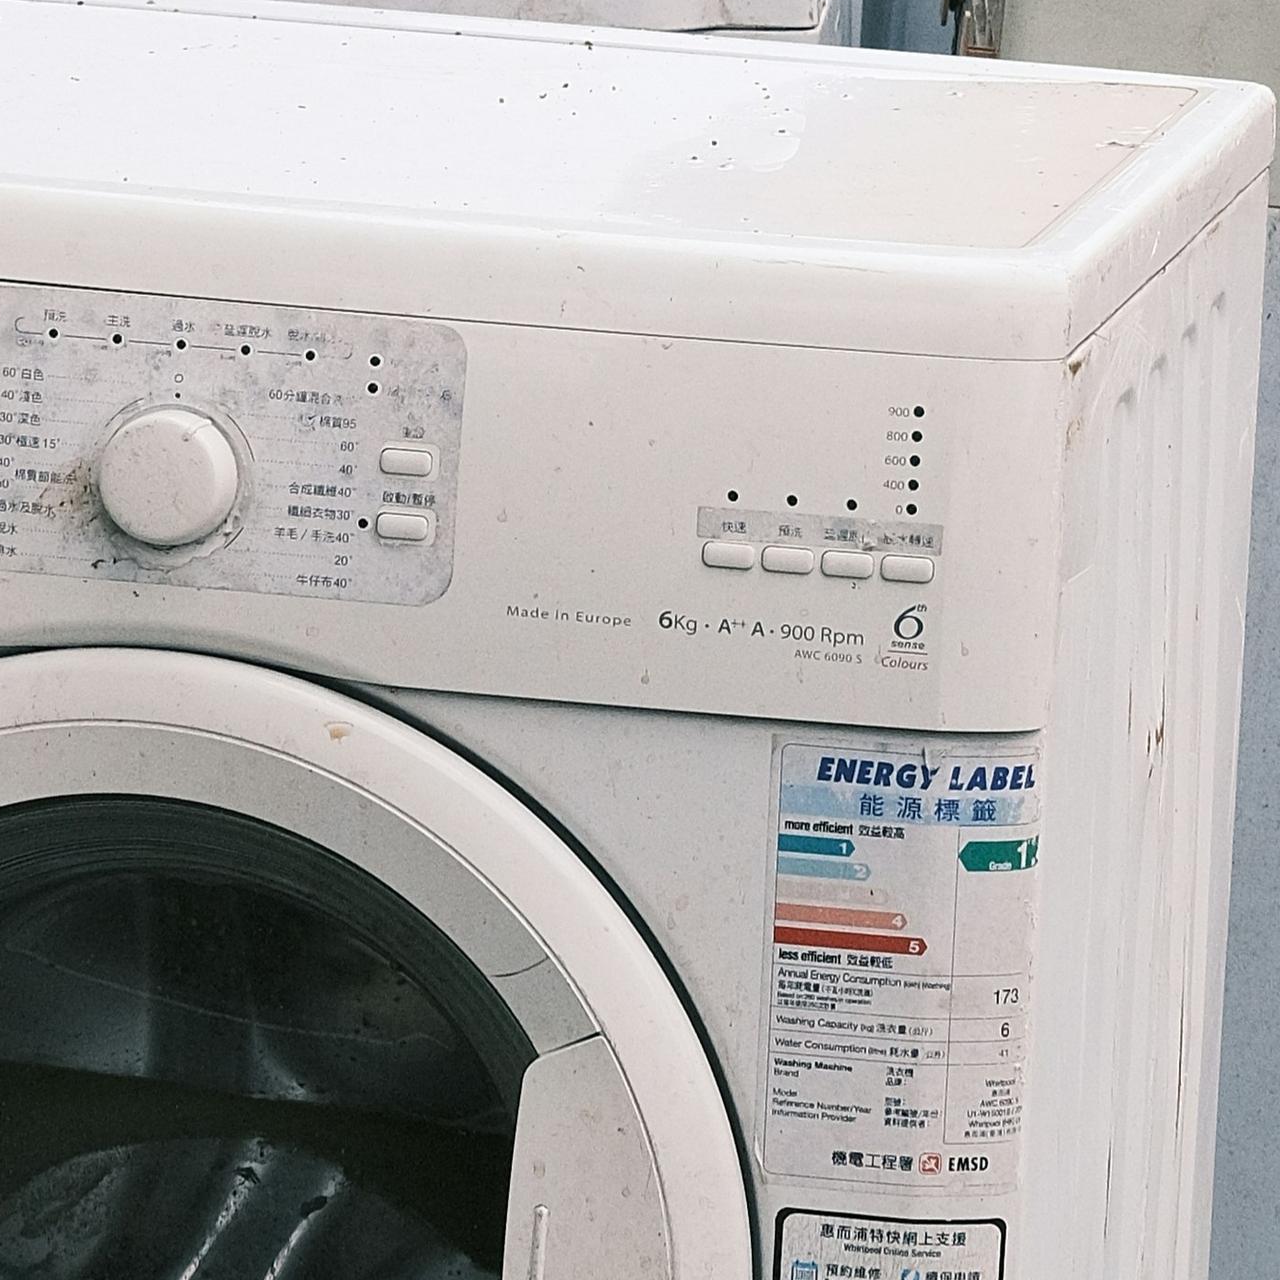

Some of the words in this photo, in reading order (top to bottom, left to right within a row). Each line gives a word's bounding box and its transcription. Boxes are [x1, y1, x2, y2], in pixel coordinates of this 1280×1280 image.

[888, 406, 910, 418] 900
[886, 430, 908, 442] 800
[884, 455, 907, 466] 600
[883, 479, 905, 491] 400
[506, 605, 549, 619] Made
[575, 611, 632, 627] Europe
[658, 610, 698, 636] 6Kg
[751, 621, 765, 637] A
[780, 624, 815, 642] 900
[820, 627, 865, 648] Rpm
[890, 639, 926, 650] sense
[794, 649, 821, 661] AWC
[824, 651, 853, 663] 6090
[856, 653, 863, 664] S
[880, 655, 929, 671] Colours
[817, 756, 940, 791] ENERGY
[948, 763, 1036, 792] LABEL
[859, 793, 998, 823] 能源標籤
[785, 819, 811, 831] more
[812, 821, 854, 835] efficient
[839, 842, 848, 855] 1
[891, 914, 903, 928] 4
[908, 941, 921, 953] 5
[778, 948, 799, 961] less
[800, 951, 842, 965] efficient
[778, 967, 808, 979] Annual
[810, 970, 841, 984] Energy
[842, 973, 902, 988] Consumption
[993, 988, 1019, 1005] 173
[776, 1015, 816, 1029] Washing
[818, 1018, 859, 1033] Capacity
[1000, 1022, 1010, 1038] 6
[774, 1037, 803, 1049] Water
[804, 1040, 867, 1055] Consumption
[773, 1067, 800, 1078] Brand
[774, 1057, 813, 1070] Washing
[814, 1061, 853, 1072] Machine
[948, 1156, 989, 1172] EMSD
[844, 1242, 881, 1255] Whirlpool
[911, 1248, 942, 1258] Service
